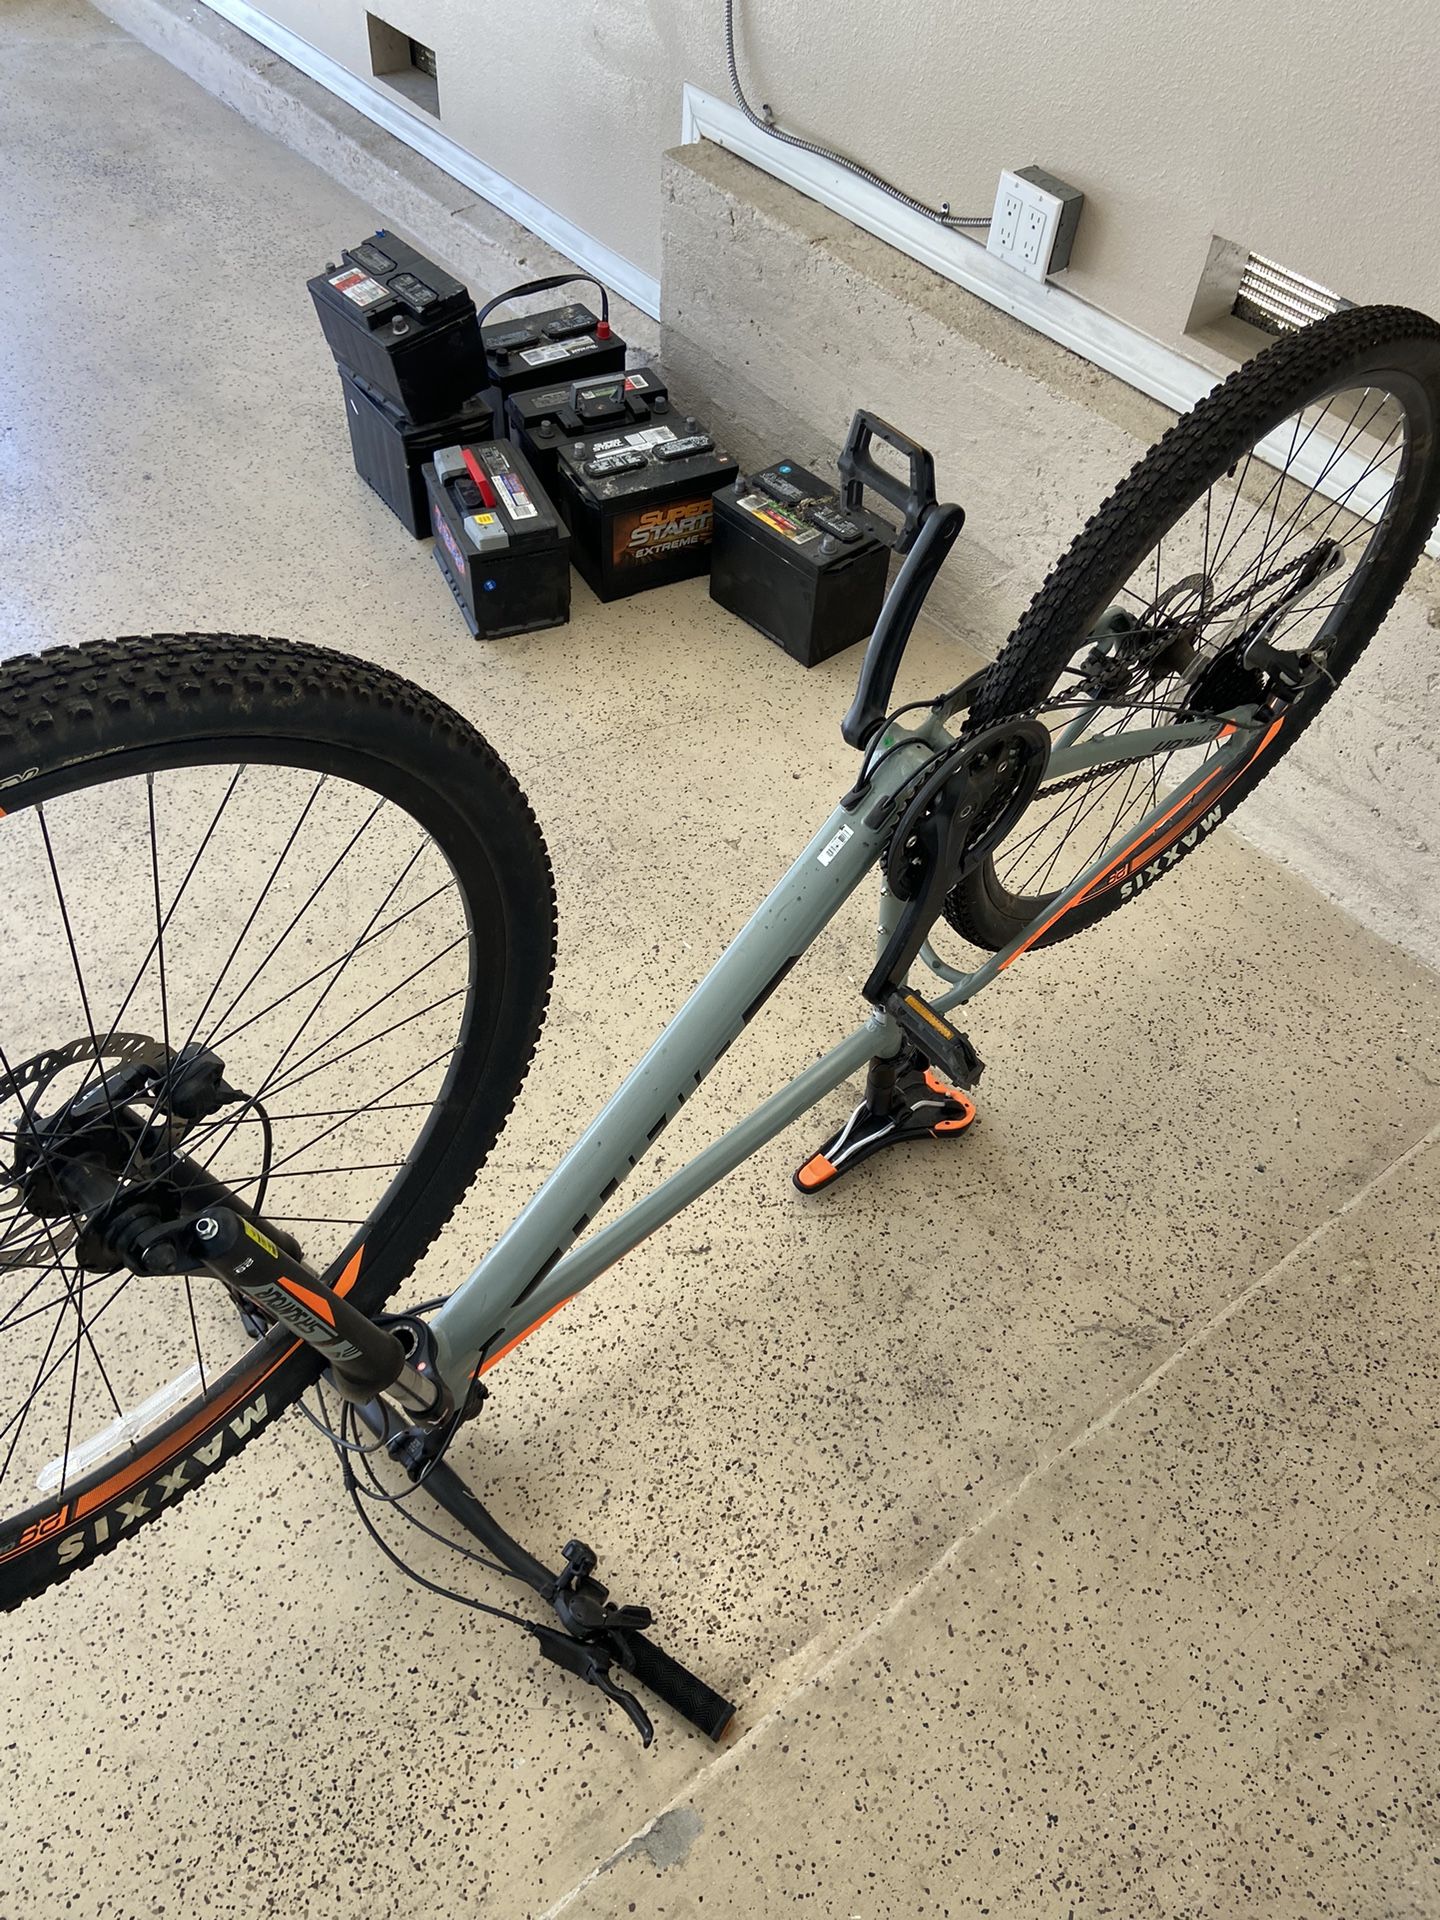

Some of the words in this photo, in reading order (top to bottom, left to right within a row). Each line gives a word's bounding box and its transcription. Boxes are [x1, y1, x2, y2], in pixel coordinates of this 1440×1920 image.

[629, 512, 713, 548] START
[639, 499, 713, 528] SUPER
[635, 534, 700, 558] EXTREME
[1120, 805, 1223, 900] MAXXIS
[57, 1393, 269, 1566] MAXXIS
